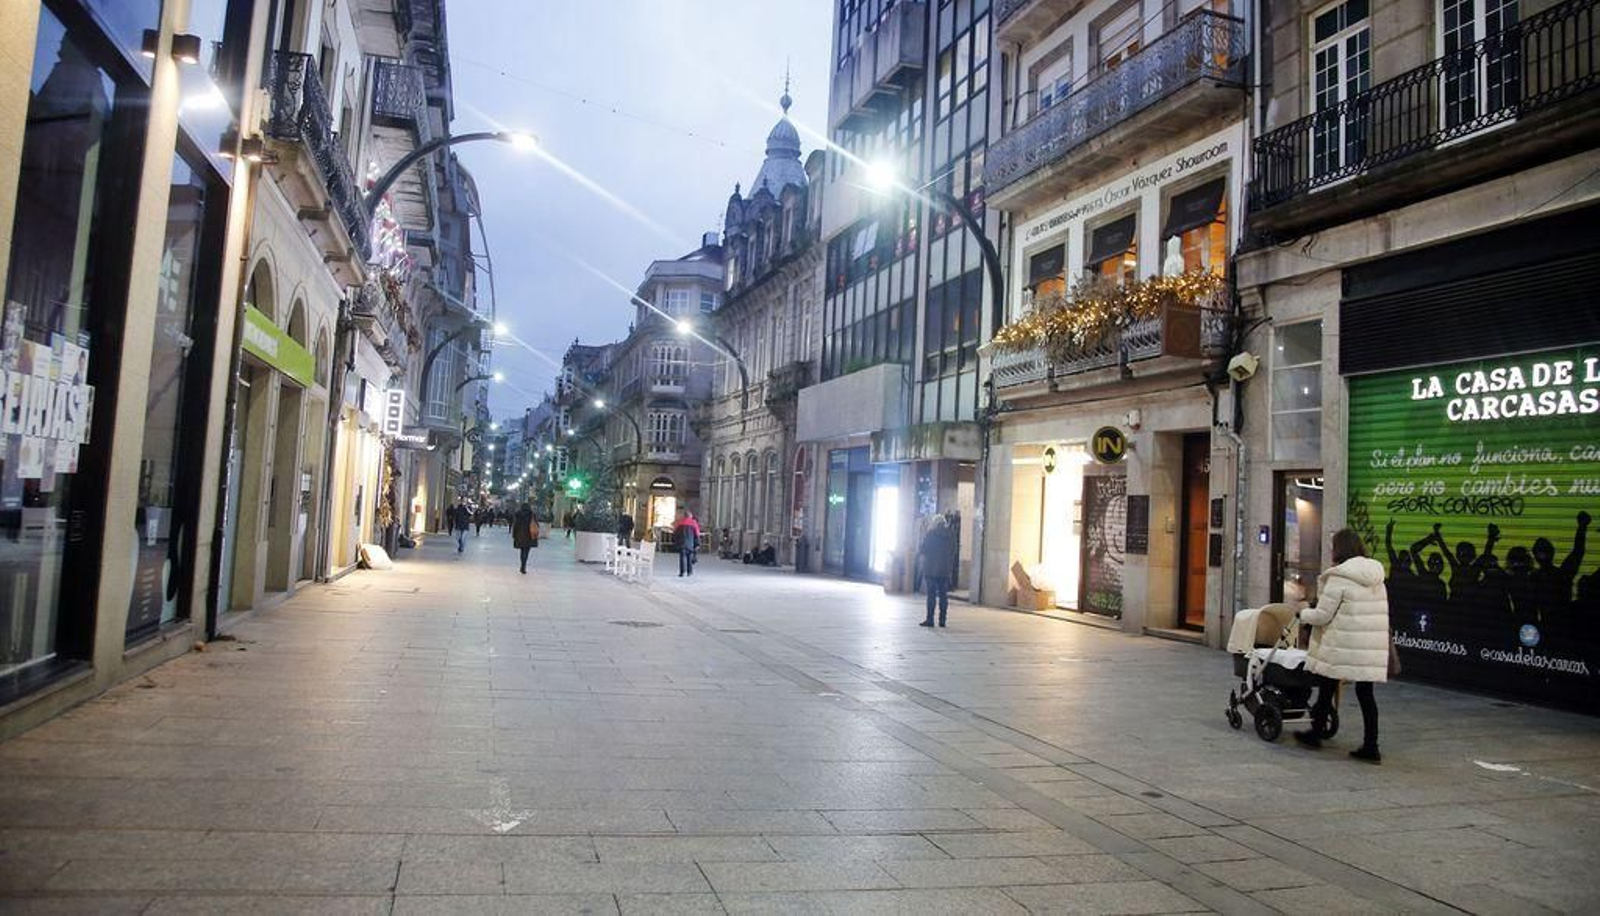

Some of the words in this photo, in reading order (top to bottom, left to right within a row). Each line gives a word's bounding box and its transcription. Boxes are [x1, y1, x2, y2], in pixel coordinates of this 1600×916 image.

[1175, 142, 1228, 173] Showroom
[1411, 376, 1444, 400] LA
[1455, 367, 1527, 395] CASA
[1532, 361, 1574, 387] DE
[1447, 388, 1599, 421] CARCASAS
[1098, 437, 1121, 454] IN
[1438, 452, 1462, 465] no
[1373, 480, 1415, 502] pero
[1421, 480, 1446, 496] no
[1461, 473, 1559, 496] cambies
